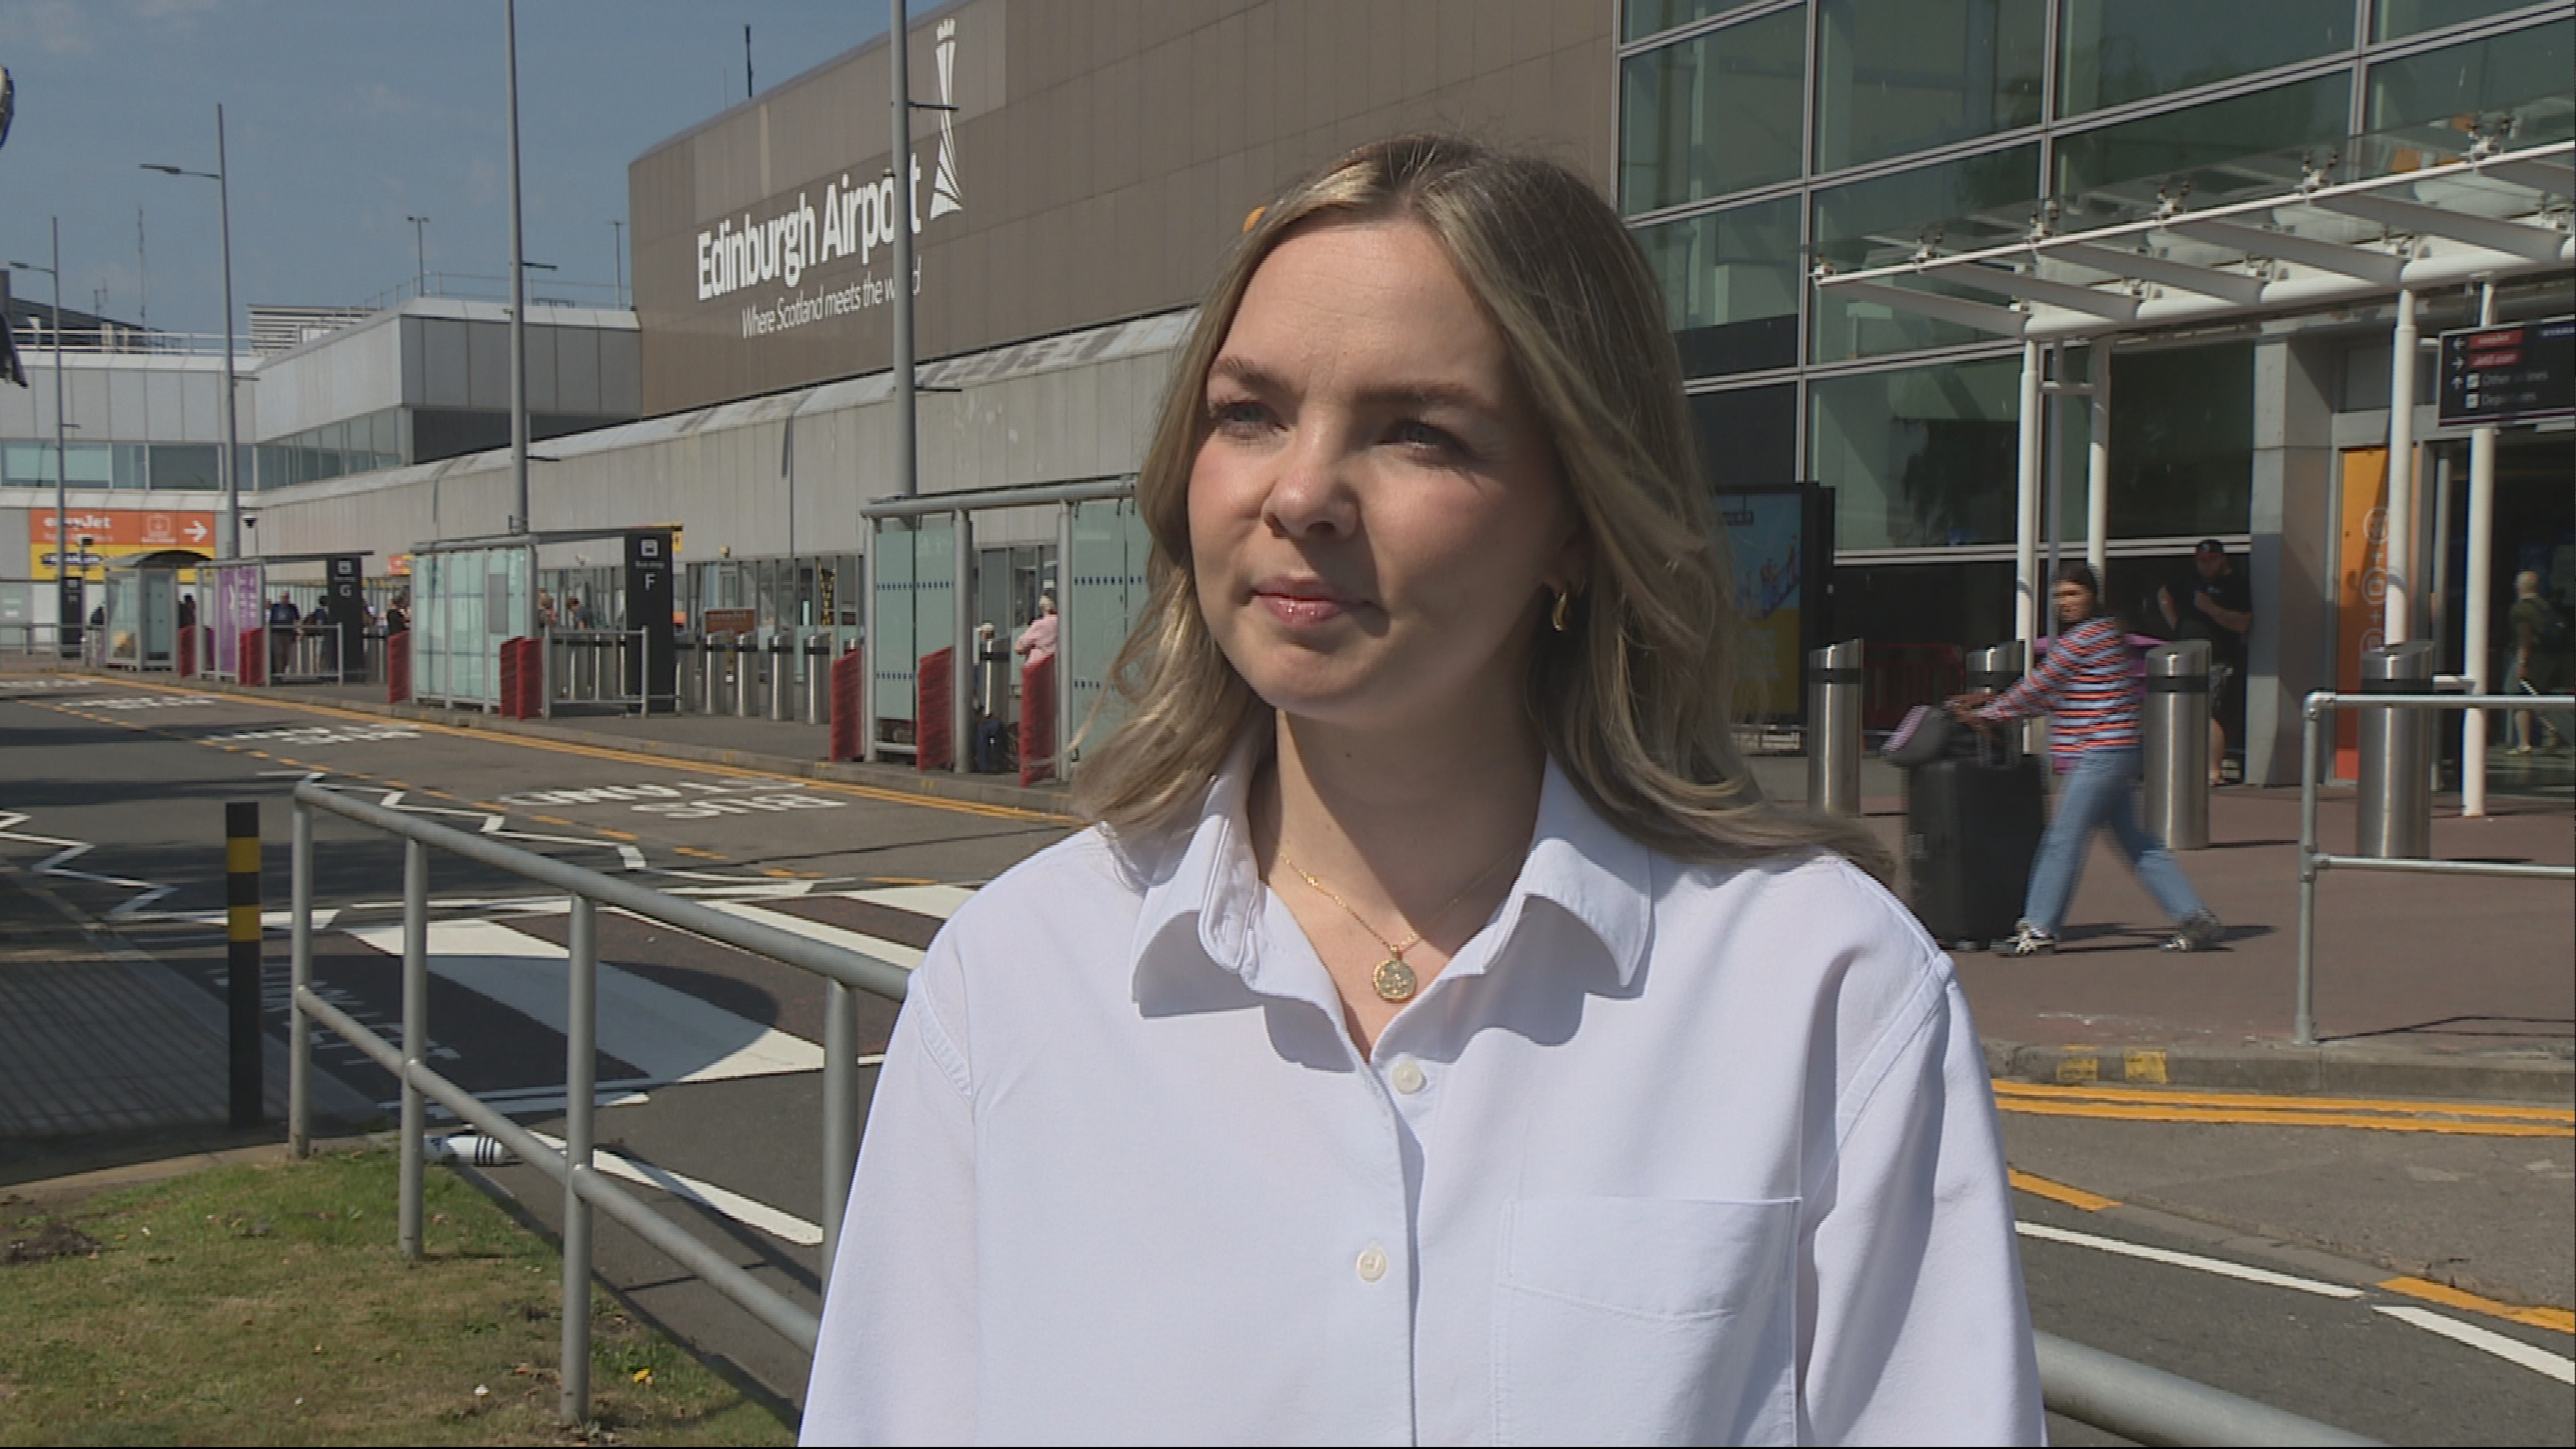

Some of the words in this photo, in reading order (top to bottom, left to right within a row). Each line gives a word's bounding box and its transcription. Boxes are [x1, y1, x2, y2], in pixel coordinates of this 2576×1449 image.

[698, 191, 816, 301] Edinburgh
[821, 153, 921, 266] Airpot
[741, 303, 775, 339] Where
[776, 284, 823, 331] Scotland
[824, 281, 861, 316] meets
[862, 270, 883, 309] the
[339, 584, 352, 598] G
[645, 572, 656, 590] F
[630, 794, 847, 818] BUS
